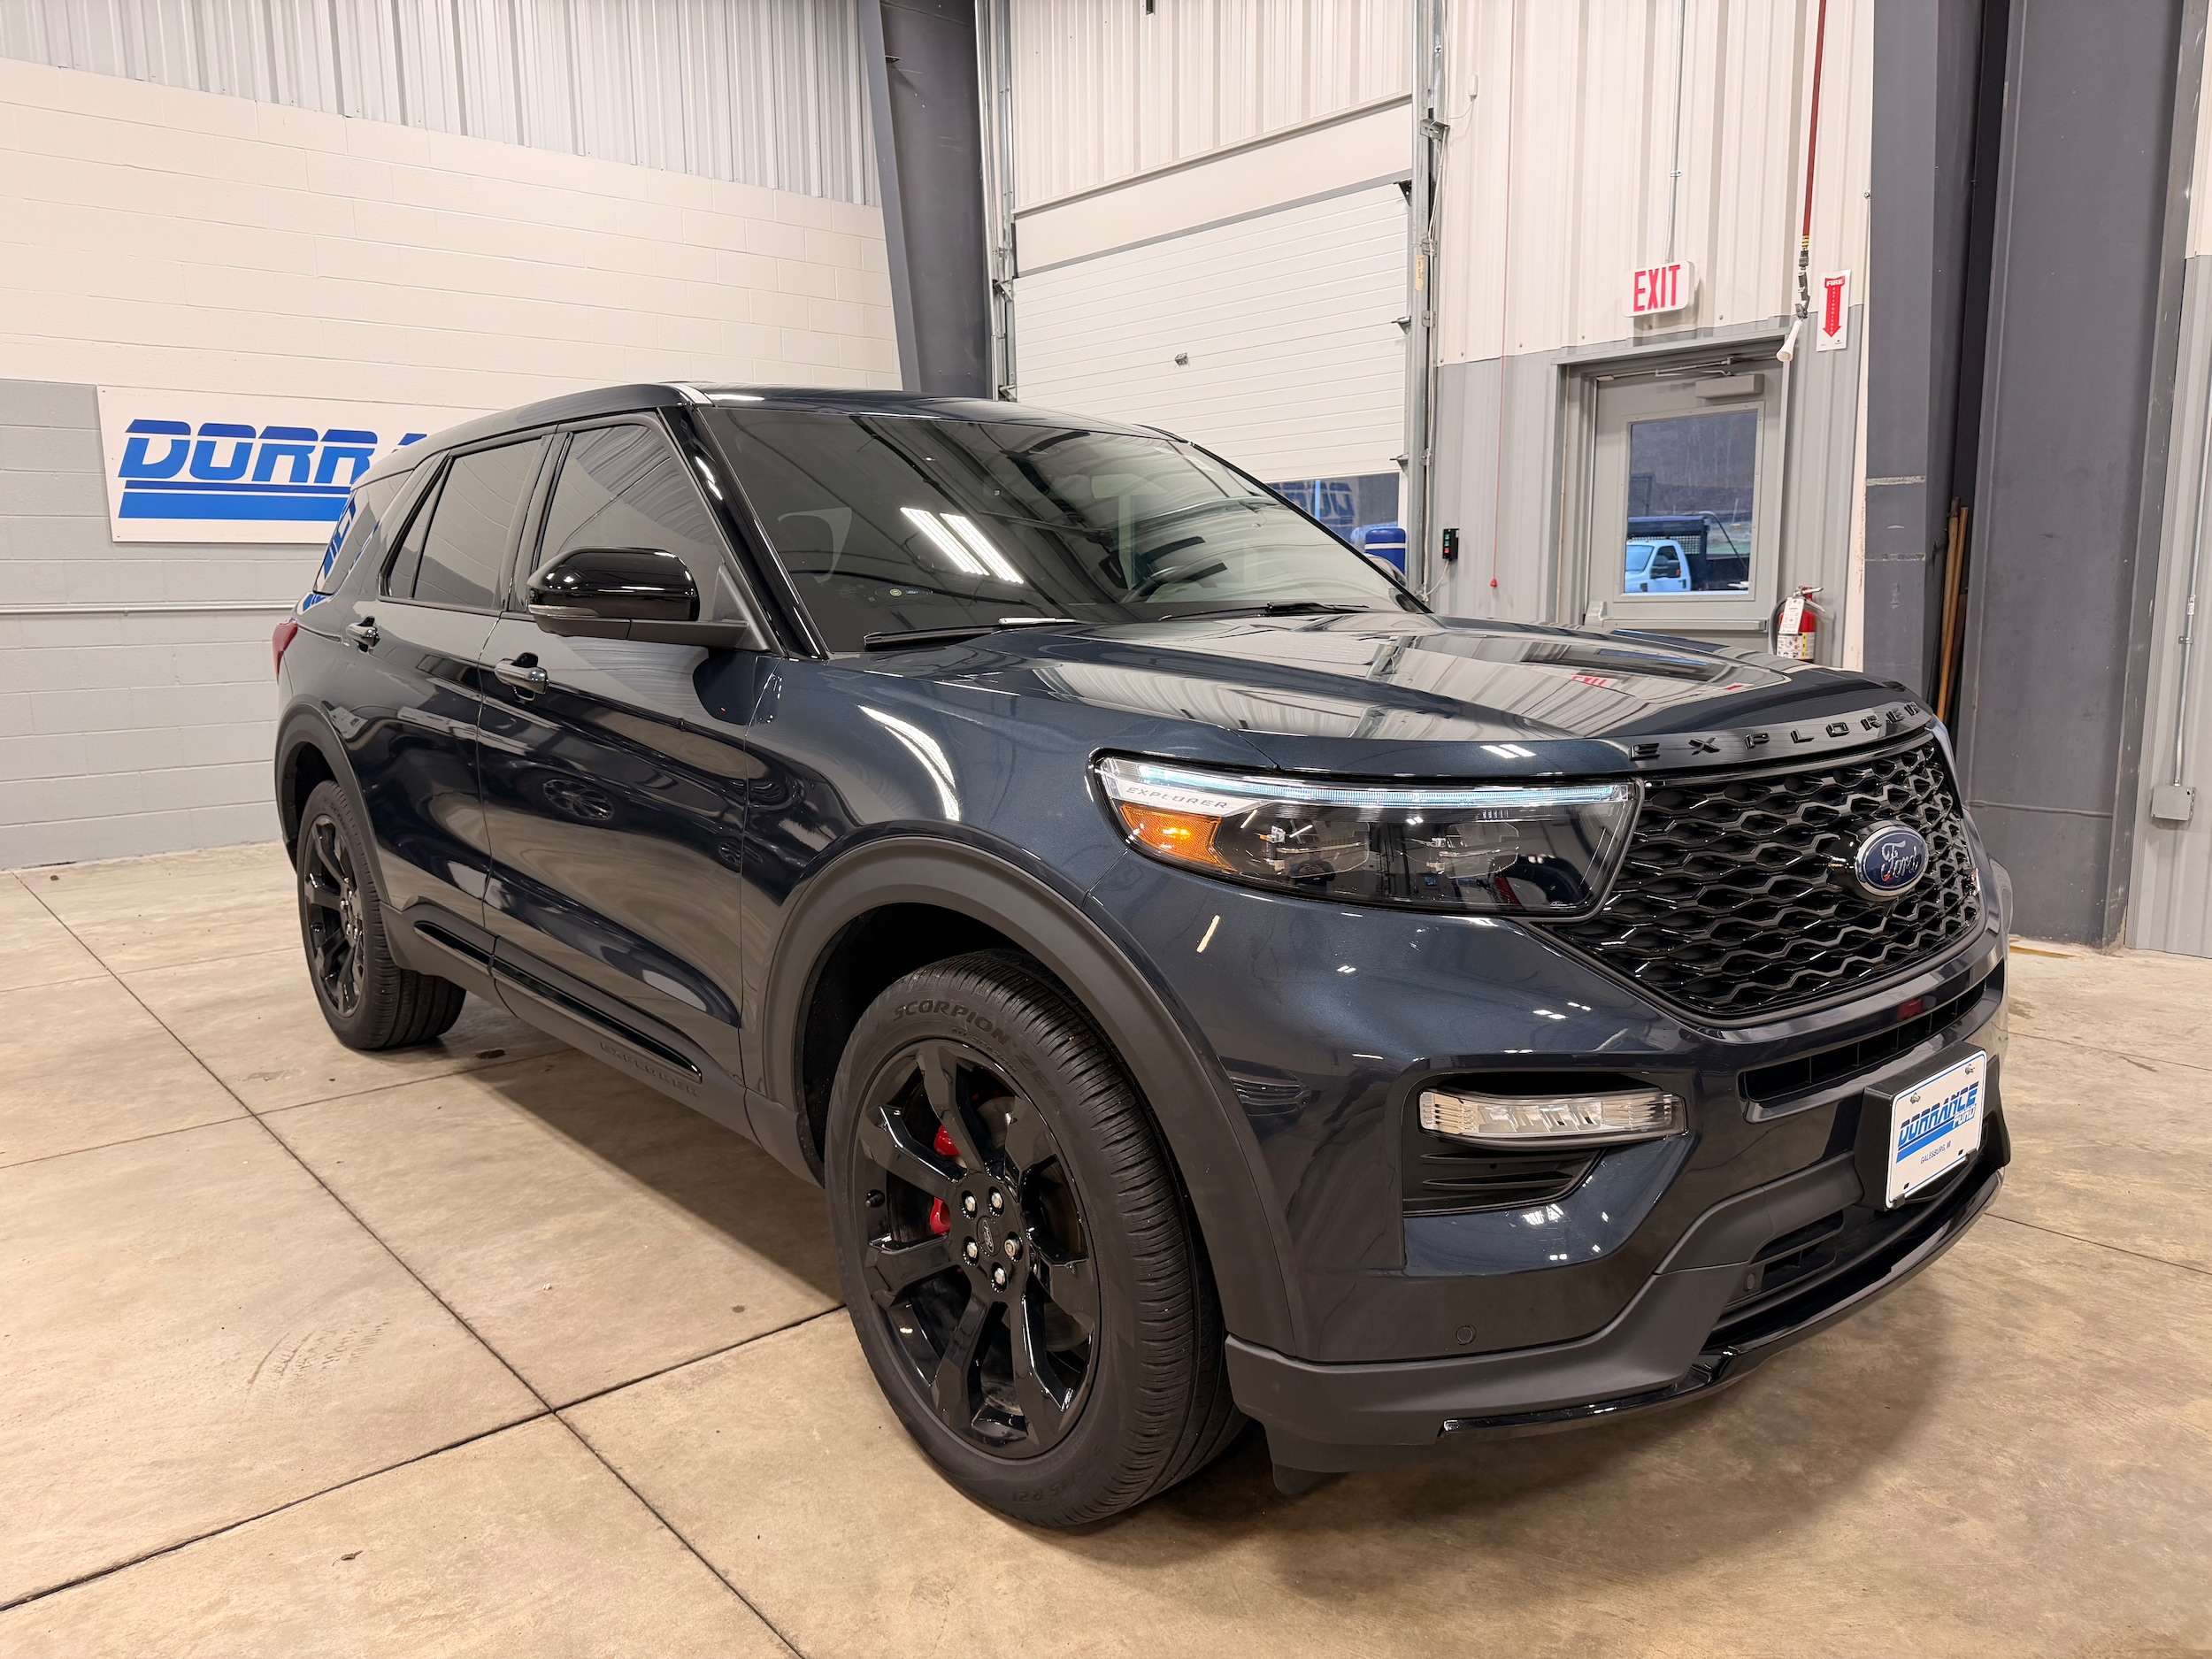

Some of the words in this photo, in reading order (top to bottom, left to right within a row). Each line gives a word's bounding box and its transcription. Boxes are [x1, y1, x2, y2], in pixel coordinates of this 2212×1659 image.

[1633, 265, 1680, 312] EXIT
[118, 419, 427, 485] DORR
[1629, 702, 1920, 761] EXPLORER
[1126, 787, 1228, 809] EXPLORER
[1881, 841, 1919, 881] Ford
[893, 999, 1011, 1046] SCORPION
[600, 1041, 698, 1097] EXPLORER
[1898, 1081, 1979, 1148] DORRANCE
[1952, 1103, 1977, 1129] FORD
